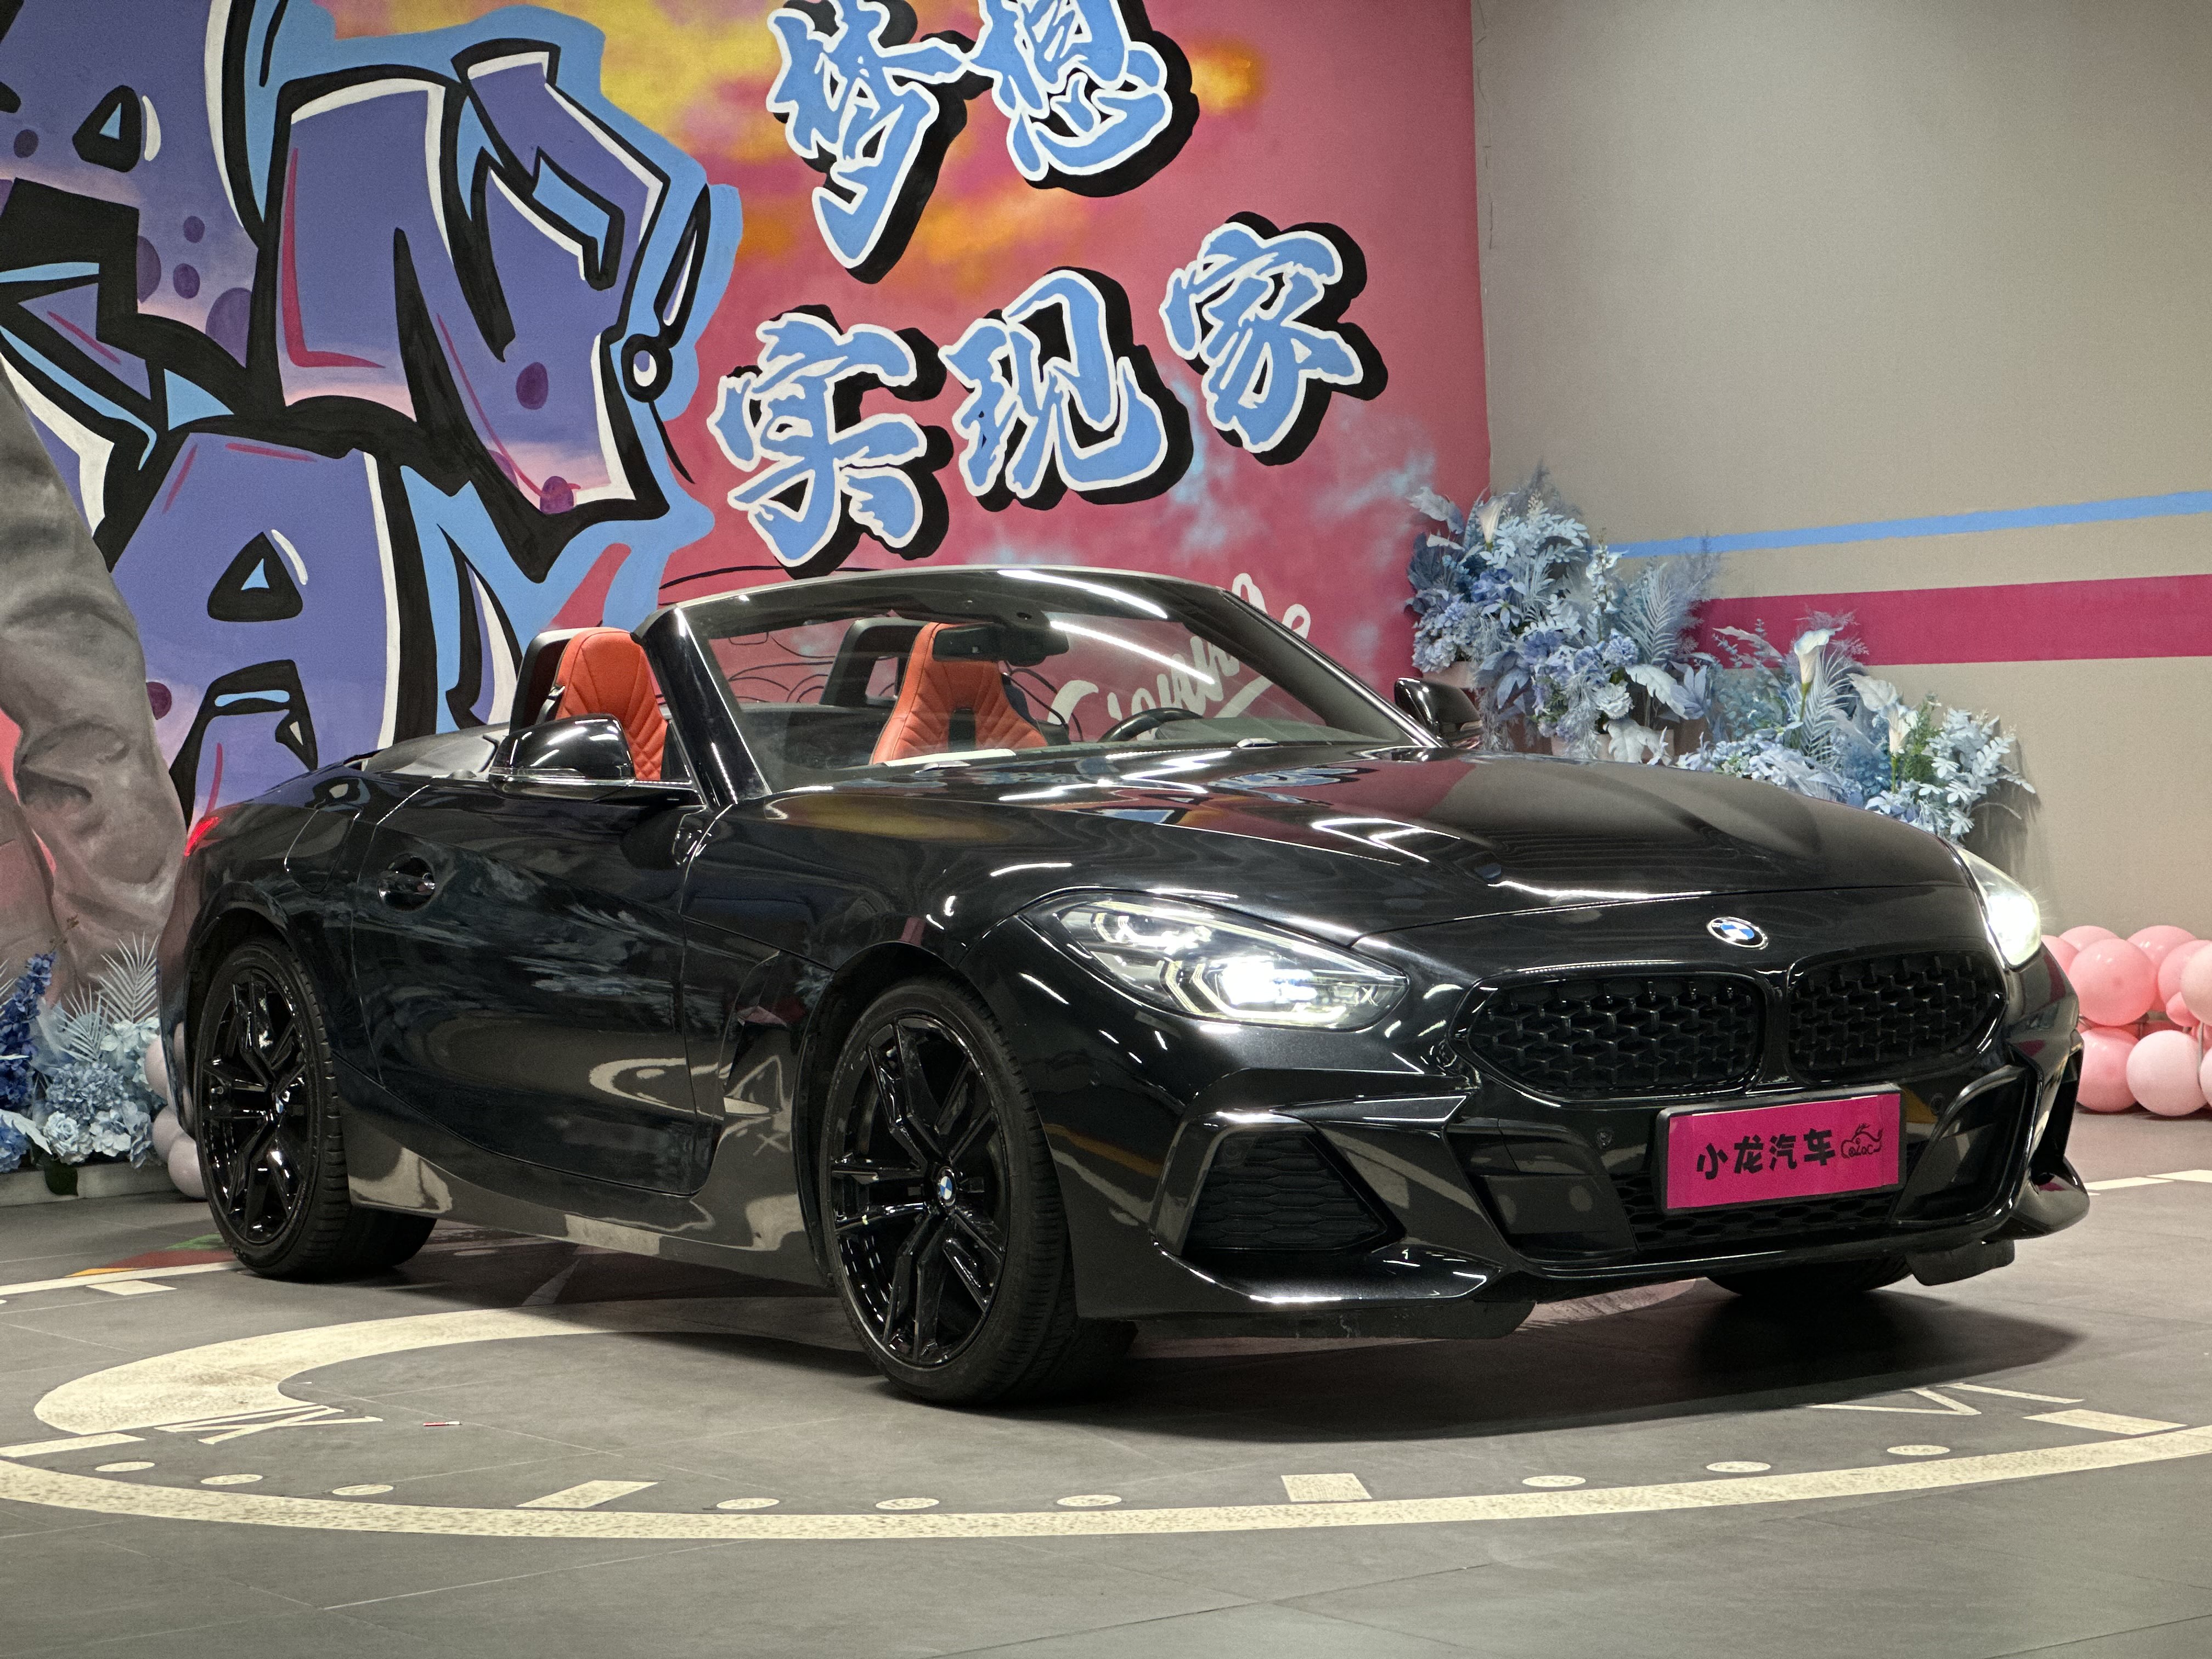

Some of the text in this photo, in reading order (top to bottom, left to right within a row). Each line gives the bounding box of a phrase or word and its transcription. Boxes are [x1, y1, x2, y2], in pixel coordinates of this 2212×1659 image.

[707, 221, 1366, 567] 实现家
[1696, 1127, 1836, 1180] 小龙汽车
